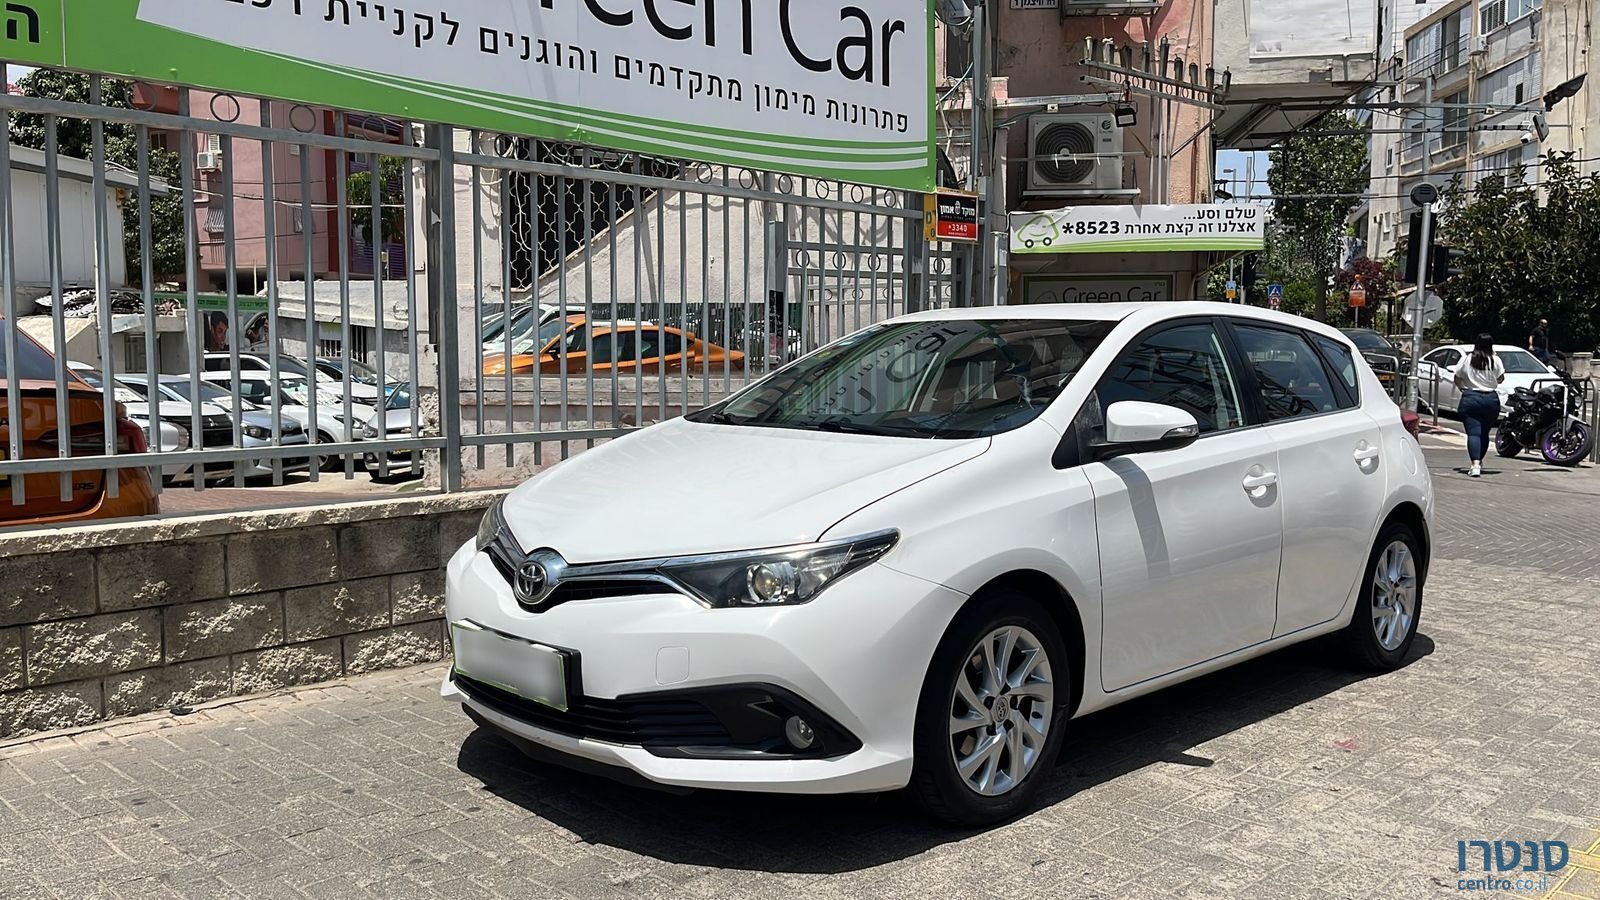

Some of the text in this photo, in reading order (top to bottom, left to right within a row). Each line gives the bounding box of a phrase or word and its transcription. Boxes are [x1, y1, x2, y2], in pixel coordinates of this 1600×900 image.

[6, 2, 40, 44] ה
[323, 0, 460, 48] לקניית
[479, 26, 598, 74] והוגנים
[779, 0, 905, 87] Car
[614, 54, 742, 101] מתקדמים
[754, 83, 816, 112] מימון
[826, 98, 908, 133] פתרונות
[1183, 207, 1256, 220] שלם וסע...
[1198, 222, 1214, 233] זה
[1218, 220, 1256, 232] אצלנו
[1124, 223, 1162, 234] אחרת
[1165, 223, 1194, 236] קצת
[1063, 286, 1161, 302] Green Car
